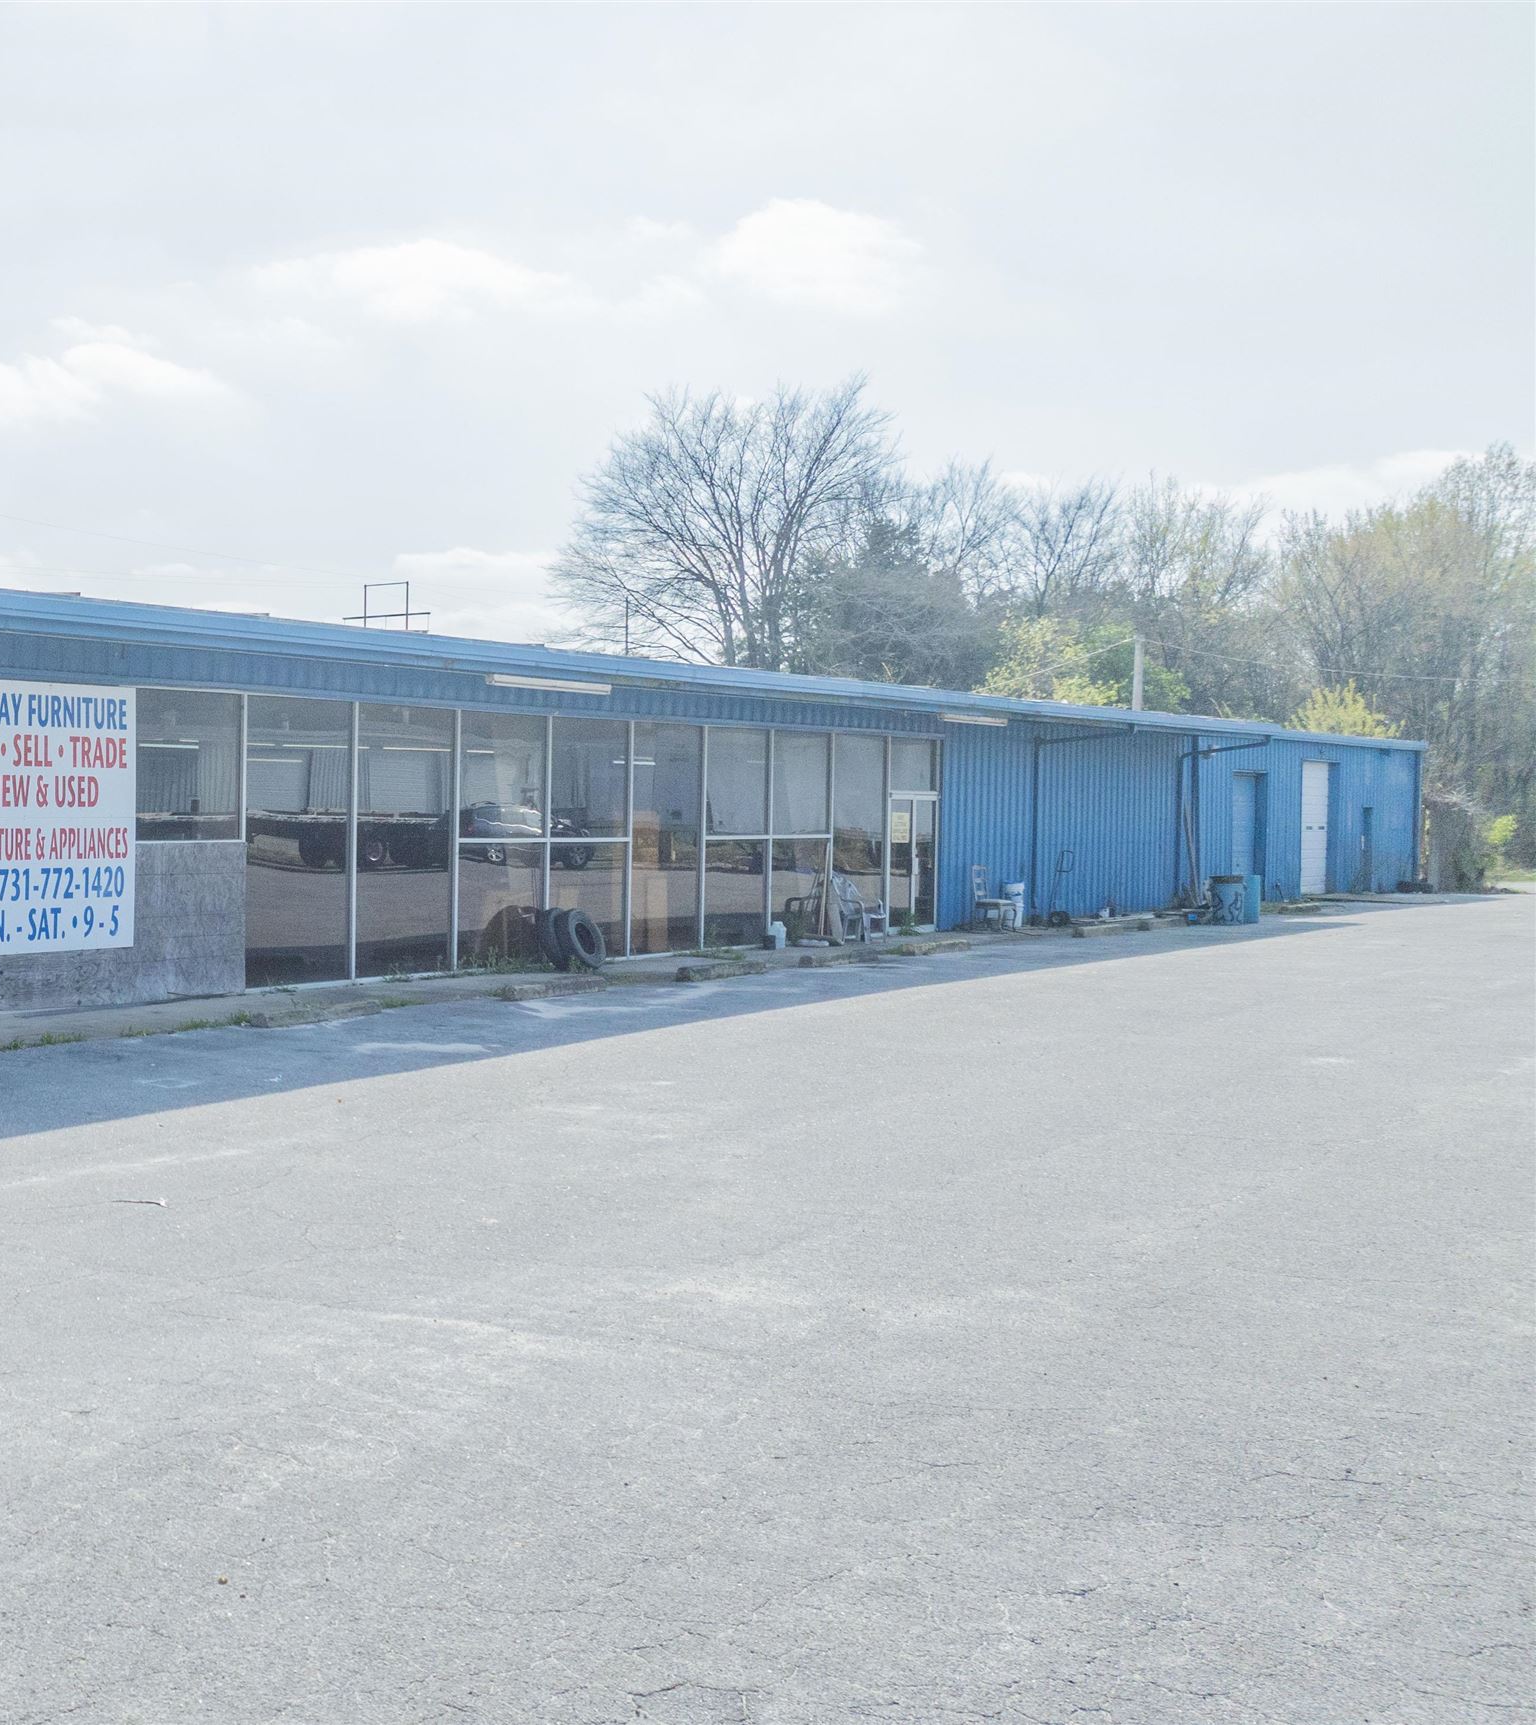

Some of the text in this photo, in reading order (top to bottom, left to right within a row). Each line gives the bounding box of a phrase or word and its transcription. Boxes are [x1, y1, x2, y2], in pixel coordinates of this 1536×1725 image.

[28, 695, 127, 730] FURNITURE
[13, 734, 52, 767] SELL
[69, 736, 127, 769] TRADE
[36, 775, 49, 807] &
[55, 775, 99, 807] USED
[36, 829, 45, 861] &
[49, 827, 128, 860] APPLIANCES
[28, 907, 65, 941] SAT.
